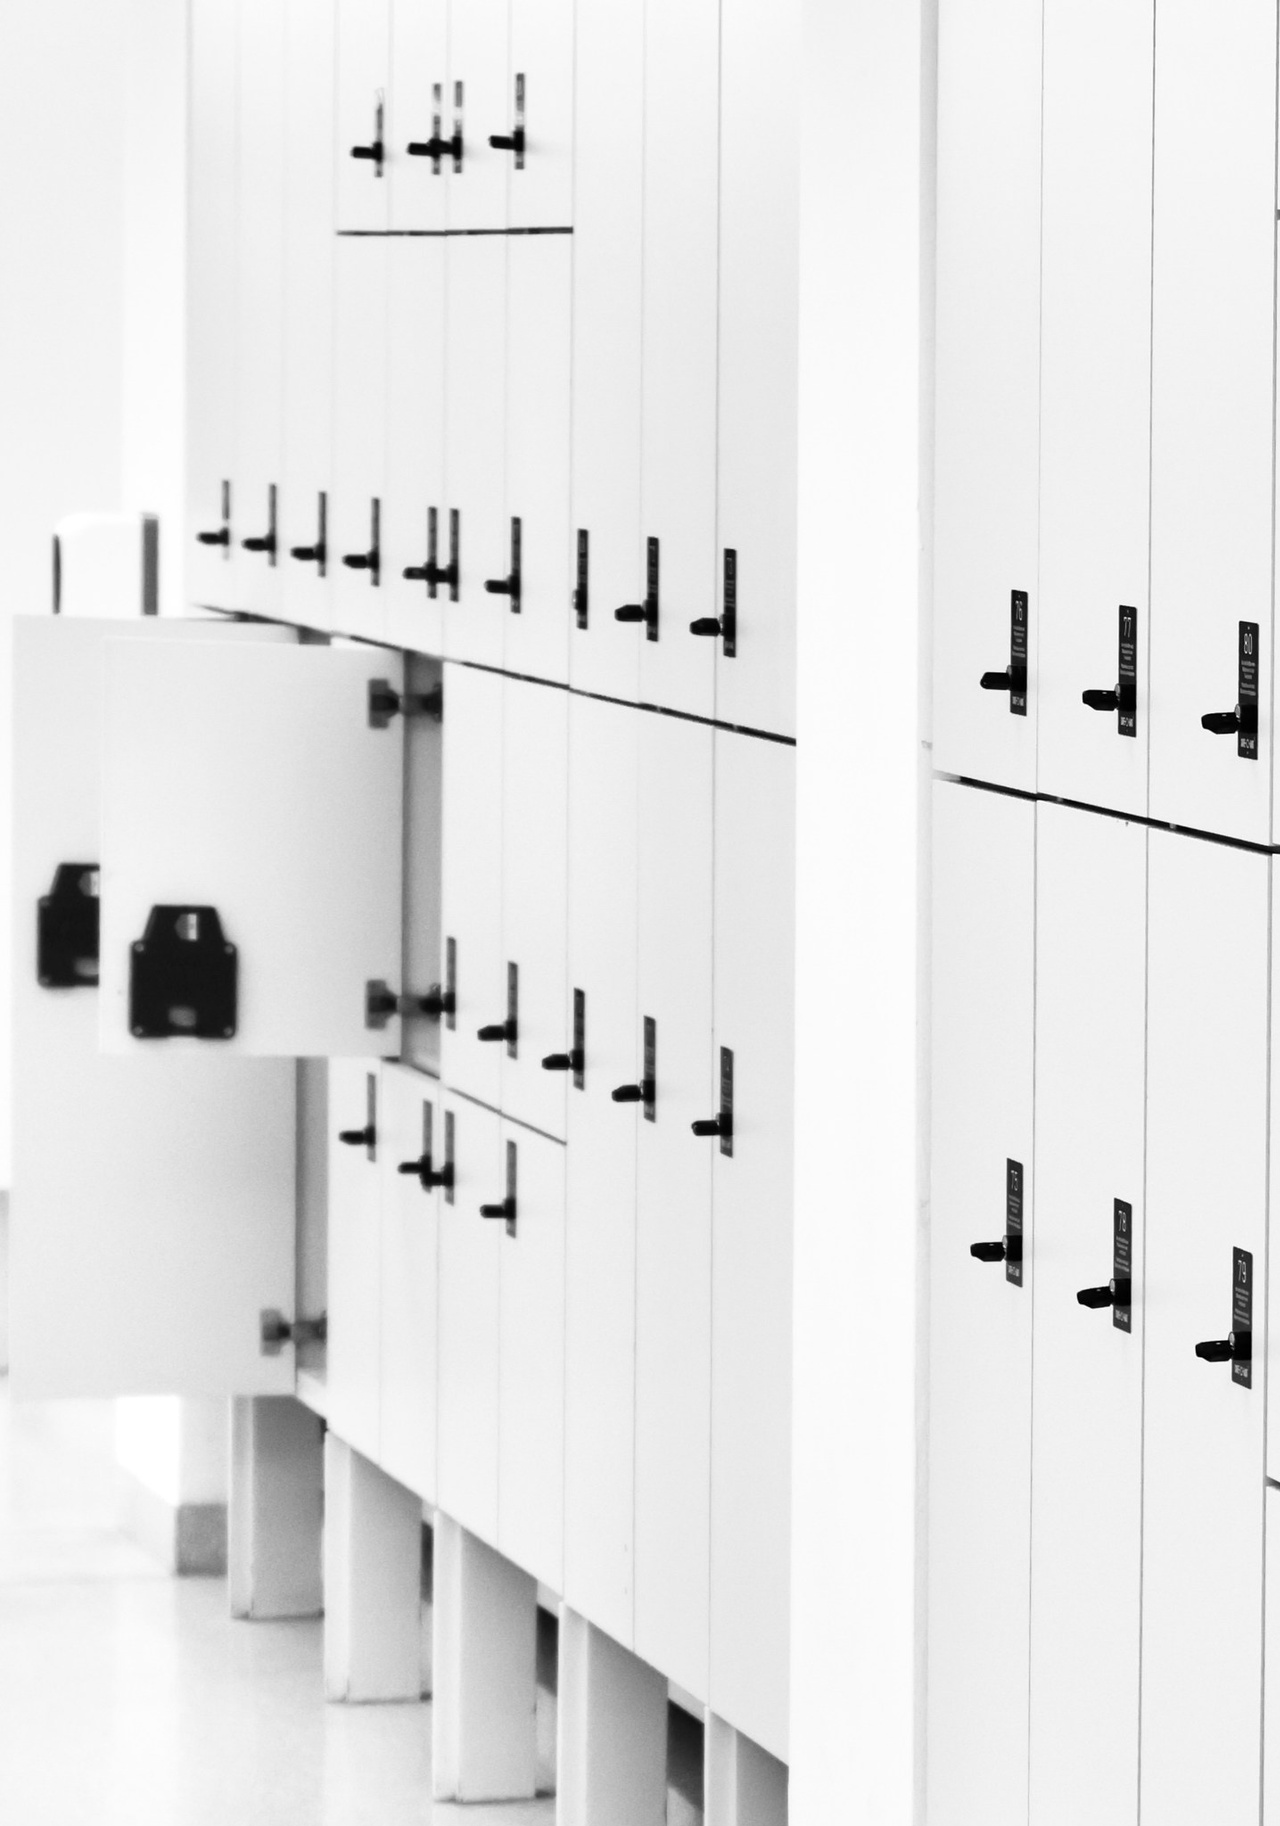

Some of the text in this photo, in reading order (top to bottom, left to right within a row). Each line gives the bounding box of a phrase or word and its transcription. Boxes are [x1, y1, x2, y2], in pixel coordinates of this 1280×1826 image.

[1015, 600, 1023, 621] 76
[1123, 616, 1132, 637] 77
[1244, 633, 1253, 655] 80
[1118, 1210, 1127, 1233] 78
[1238, 1260, 1247, 1283] 79
